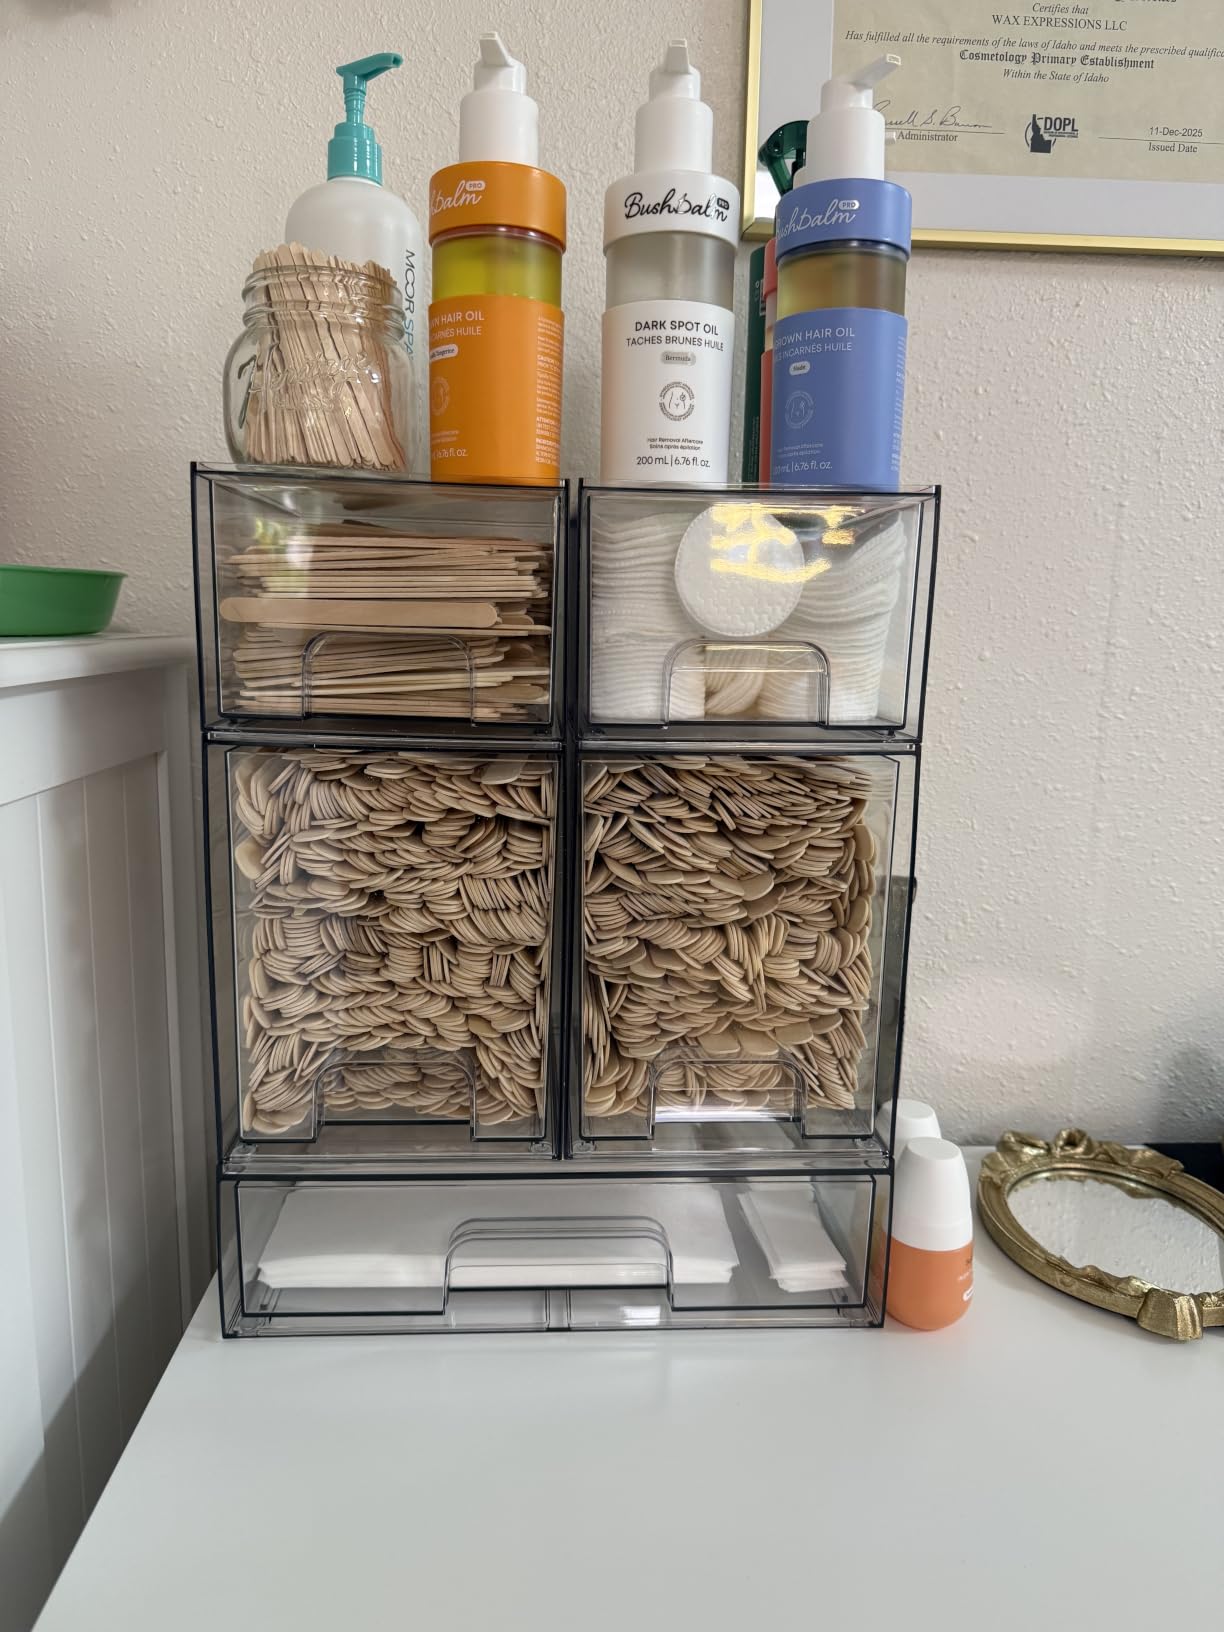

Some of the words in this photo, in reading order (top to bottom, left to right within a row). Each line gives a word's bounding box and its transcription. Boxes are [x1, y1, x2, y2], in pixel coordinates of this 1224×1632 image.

[1032, 3, 1069, 14] Certifies
[1071, 4, 1089, 15] that
[992, 14, 1020, 25] WAX
[1023, 16, 1102, 30] EXPRESSIONS
[1105, 20, 1128, 31] LLC
[845, 30, 864, 40] Has
[864, 31, 901, 43] fulfilled
[902, 32, 914, 42] all
[916, 33, 930, 44] the
[932, 35, 989, 49] requirements
[991, 37, 1003, 52] of
[1003, 37, 1017, 48] the
[1019, 38, 1039, 49] laws
[1041, 39, 1052, 53] of
[1052, 40, 1077, 50] Idaho
[1080, 41, 1097, 51] and
[1098, 43, 1123, 53] meets
[1124, 44, 1139, 54] the
[1139, 45, 1186, 56] prescribed
[959, 50, 1027, 65] Cosmetology
[1031, 52, 1076, 66] Primary
[1080, 54, 1155, 69] Establishment
[1003, 69, 1032, 80] Within
[1034, 70, 1048, 80] the
[1049, 70, 1072, 82] State
[1073, 72, 1084, 84] of
[1084, 73, 1110, 83] Idaho
[1043, 116, 1079, 132] DOPL
[898, 130, 959, 143] Administrator
[1149, 126, 1203, 138] 11-Dec-2025
[1148, 142, 1175, 152] Issued
[1177, 143, 1198, 153] Date
[624, 188, 728, 222] Bushbalm
[441, 311, 463, 325] HAIR
[465, 310, 485, 321] OIL
[456, 326, 482, 336] HUILE
[635, 320, 667, 332] DARK
[670, 320, 701, 332] SPOT
[703, 323, 719, 336] OIL
[806, 328, 832, 340] HAIR
[836, 327, 855, 337] OIL
[626, 336, 663, 347] TACHES
[665, 335, 703, 347] BRUNES
[704, 339, 724, 352] HUILE
[782, 343, 822, 360] INCARNÉS
[825, 342, 852, 352] HUILE
[636, 456, 654, 466] 200
[654, 455, 669, 466] mL
[674, 456, 691, 466] 6.76
[692, 456, 700, 466] fl.
[700, 459, 711, 468] oz.
[794, 462, 810, 472] 6.76
[810, 460, 818, 470] fl.
[819, 461, 833, 470] oz.
